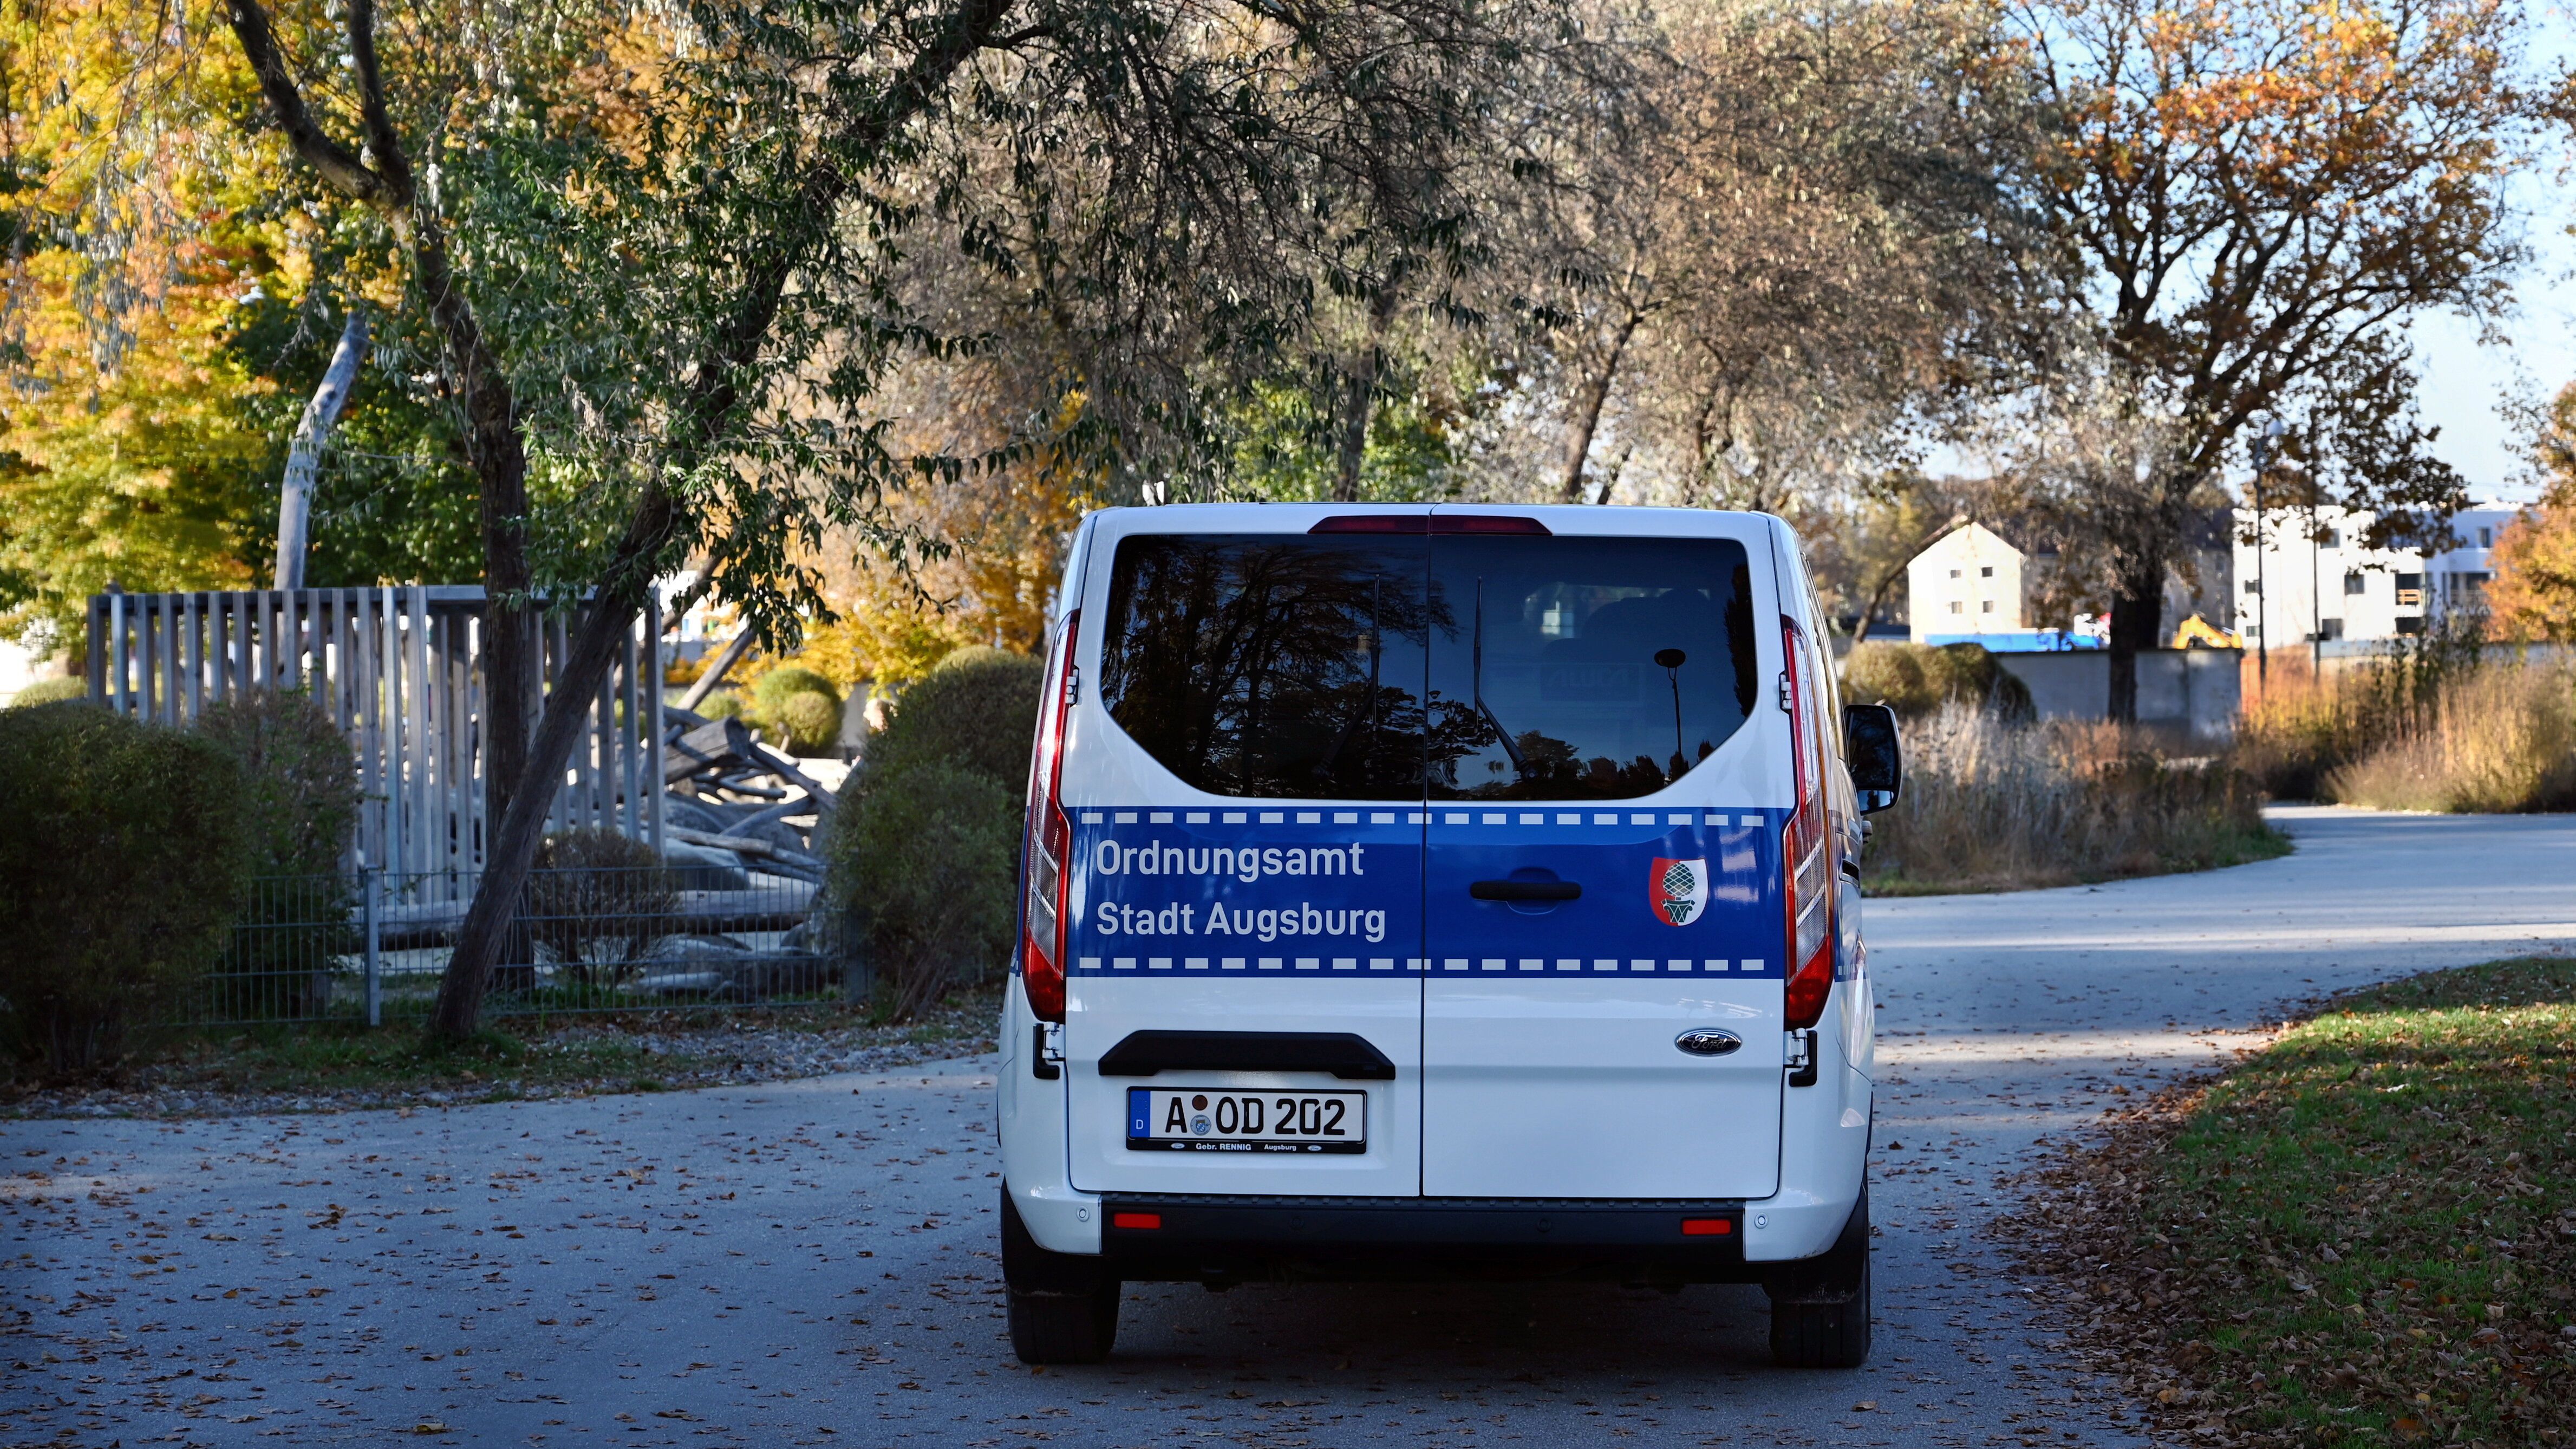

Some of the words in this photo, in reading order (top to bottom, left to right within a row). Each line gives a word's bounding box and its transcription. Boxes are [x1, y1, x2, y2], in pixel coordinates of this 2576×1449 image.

[1097, 840, 1364, 882] Ordnungsamt
[1097, 901, 1195, 935] Stadt
[1204, 901, 1385, 942] Augsburg
[1691, 1034, 1727, 1049] Ford
[1136, 1119, 1144, 1129] D
[1165, 1097, 1188, 1133] A
[1215, 1096, 1264, 1134] OD
[1275, 1098, 1346, 1136] 202
